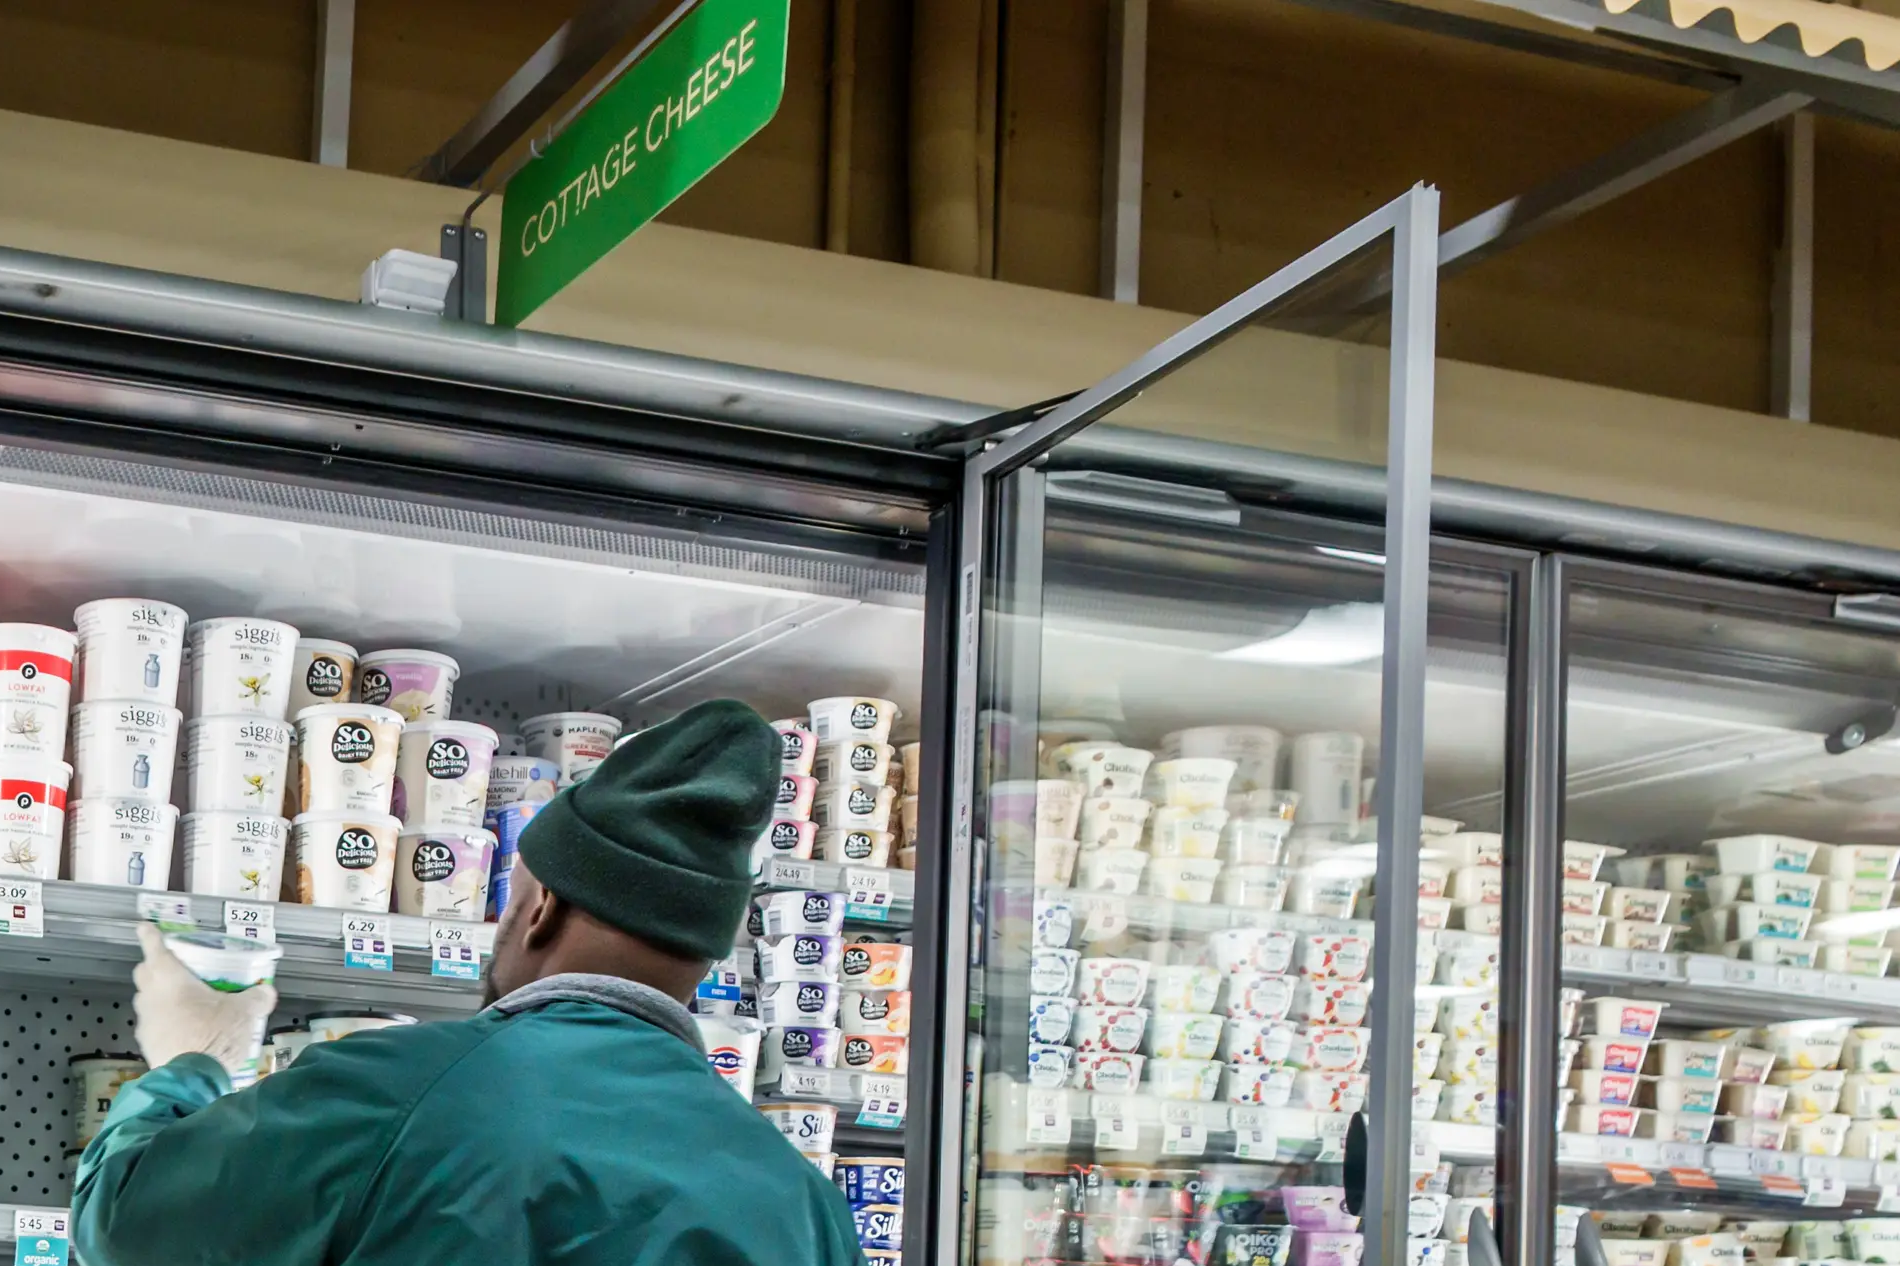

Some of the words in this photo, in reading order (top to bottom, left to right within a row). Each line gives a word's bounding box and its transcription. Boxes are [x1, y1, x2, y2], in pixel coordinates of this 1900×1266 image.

[520, 126, 640, 258] COTTAGE
[645, 19, 757, 154] CHEESE
[312, 661, 341, 678] SO
[337, 726, 372, 743] SO
[568, 726, 596, 735] MAPLE
[334, 742, 374, 753] Delicious
[433, 743, 466, 760] SO
[429, 759, 468, 769] Delicious
[417, 845, 450, 862] SO
[775, 866, 801, 880] 2/4.19
[230, 908, 259, 923] 5.29
[347, 919, 376, 934] 6.29
[435, 927, 463, 941] 6.29
[711, 988, 726, 996] new
[799, 1113, 831, 1137] Silk
[23, 1254, 60, 1266] organic
